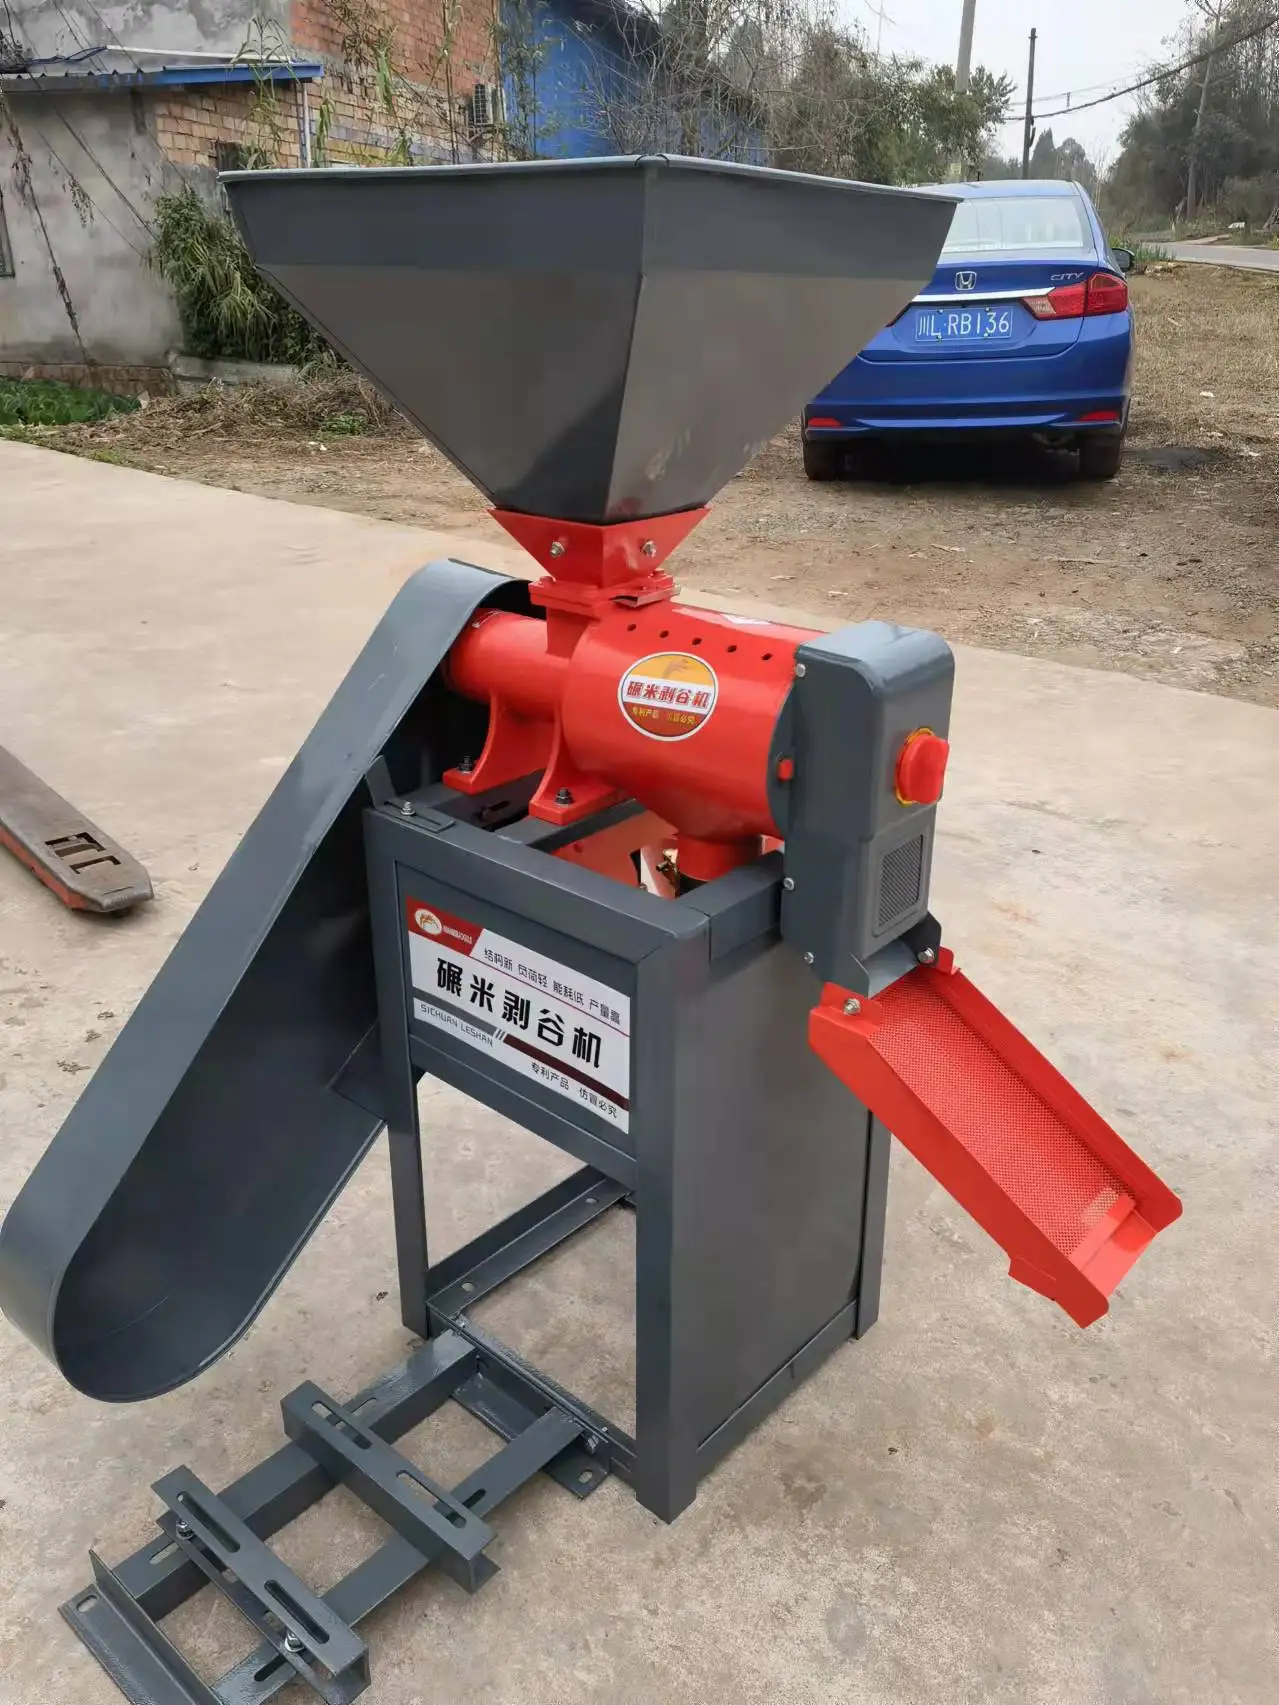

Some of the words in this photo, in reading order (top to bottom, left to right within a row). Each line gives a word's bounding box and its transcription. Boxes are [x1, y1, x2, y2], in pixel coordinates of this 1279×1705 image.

[1050, 272, 1084, 281] CITY
[626, 681, 710, 709] 碾米剥谷机
[484, 948, 513, 971] 结构新
[518, 963, 548, 988] 负荷轻
[552, 980, 585, 1006] 能耗低
[420, 1004, 458, 1027] SICHUAN
[461, 1023, 493, 1047] LESHAN
[437, 957, 602, 1068] 碾米剥谷机
[531, 1062, 569, 1091] 专利产品
[579, 1088, 618, 1119] 仿冒必究
